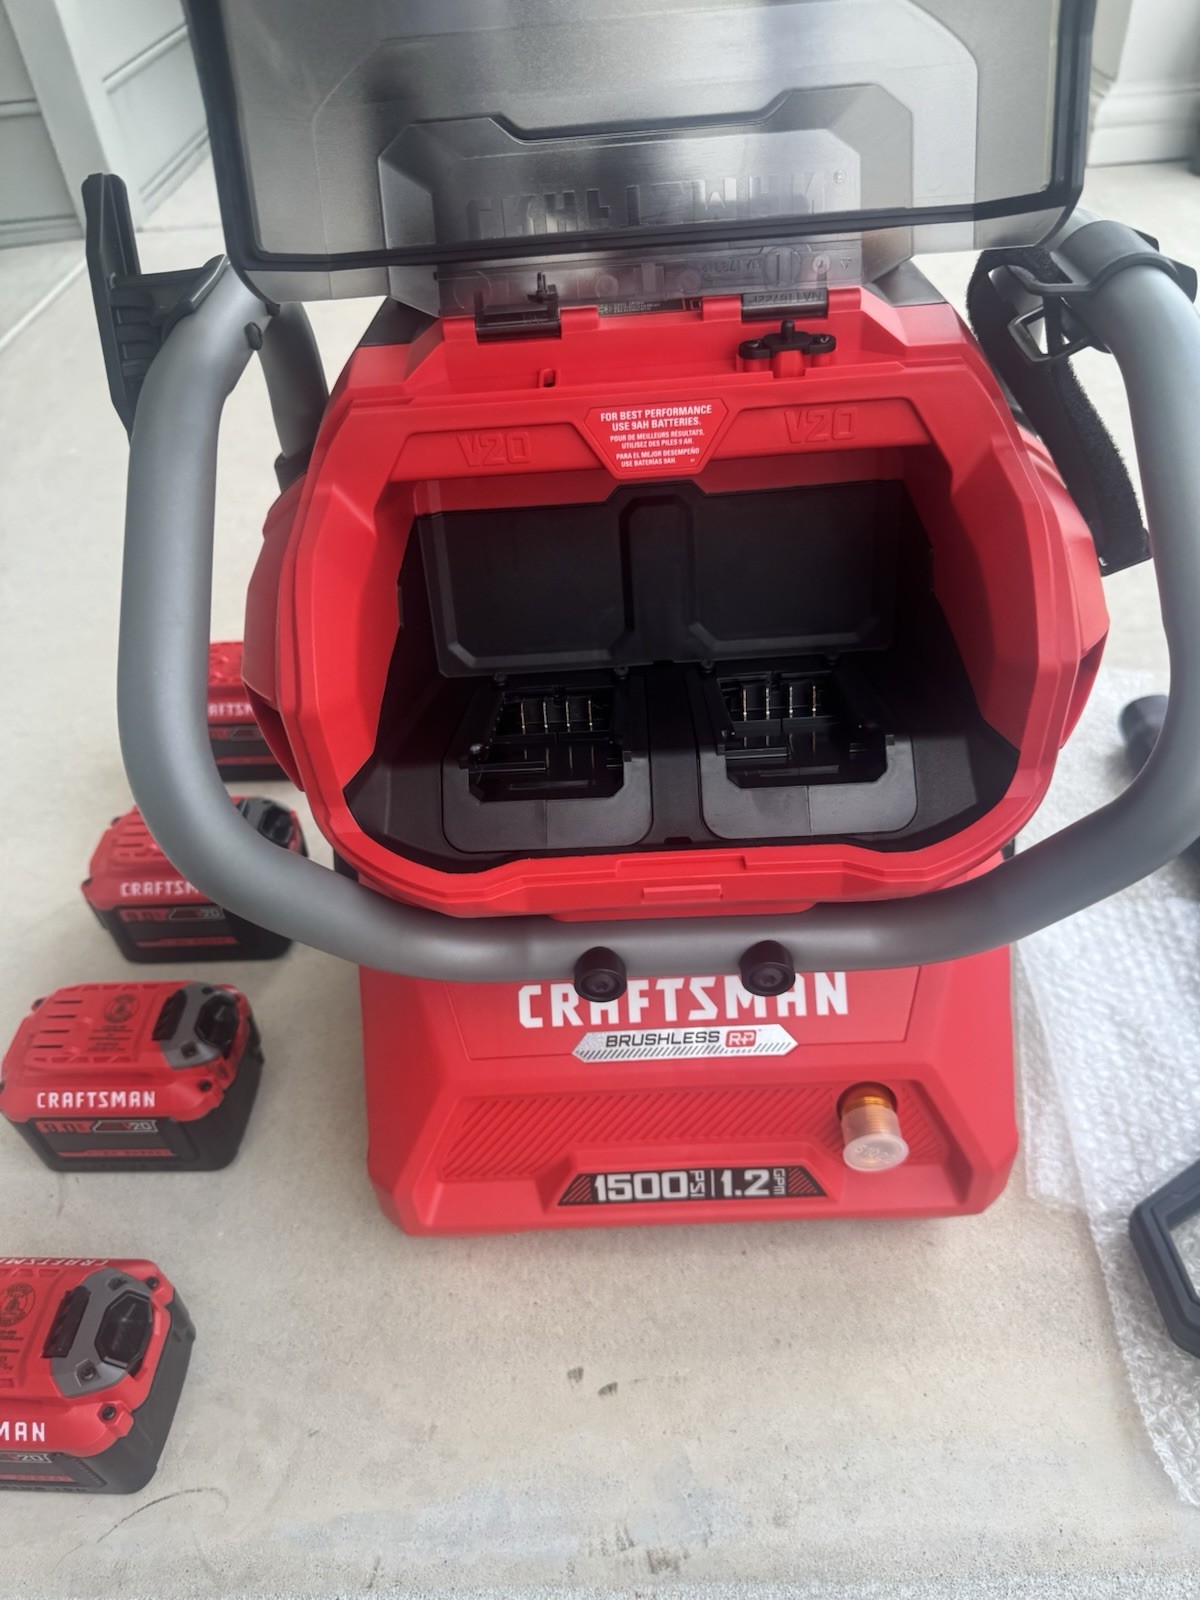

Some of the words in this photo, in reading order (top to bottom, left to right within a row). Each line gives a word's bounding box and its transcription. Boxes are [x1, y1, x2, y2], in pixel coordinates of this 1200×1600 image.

[600, 412, 618, 422] FOR
[620, 410, 642, 420] BEST
[645, 405, 712, 419] PERFORMANCE
[612, 422, 629, 432] USE
[631, 421, 649, 431] 9AH
[651, 417, 701, 429] BATTERIES.
[783, 407, 857, 444] V20
[610, 434, 626, 443] POUR
[637, 432, 669, 441] MEILLEURS
[622, 441, 647, 450] UTILISEZ
[648, 440, 660, 448] DES
[661, 438, 677, 447] PILES
[678, 438, 683, 446] 9
[457, 431, 532, 468] V20
[616, 452, 632, 460] PARA
[633, 451, 640, 459] EL
[641, 450, 662, 458] MEJOR
[663, 447, 700, 456] DESEMPEÑO
[621, 460, 633, 468] USE
[518, 972, 849, 1028] CRAFTSMAN
[606, 1031, 720, 1048] BRUSHLESS
[37, 1091, 155, 1108] CRAFTSMAN
[594, 1171, 689, 1201] 1500
[690, 1170, 705, 1198] PSI
[721, 1169, 770, 1197] 1.2
[773, 1168, 785, 1195] GPM
